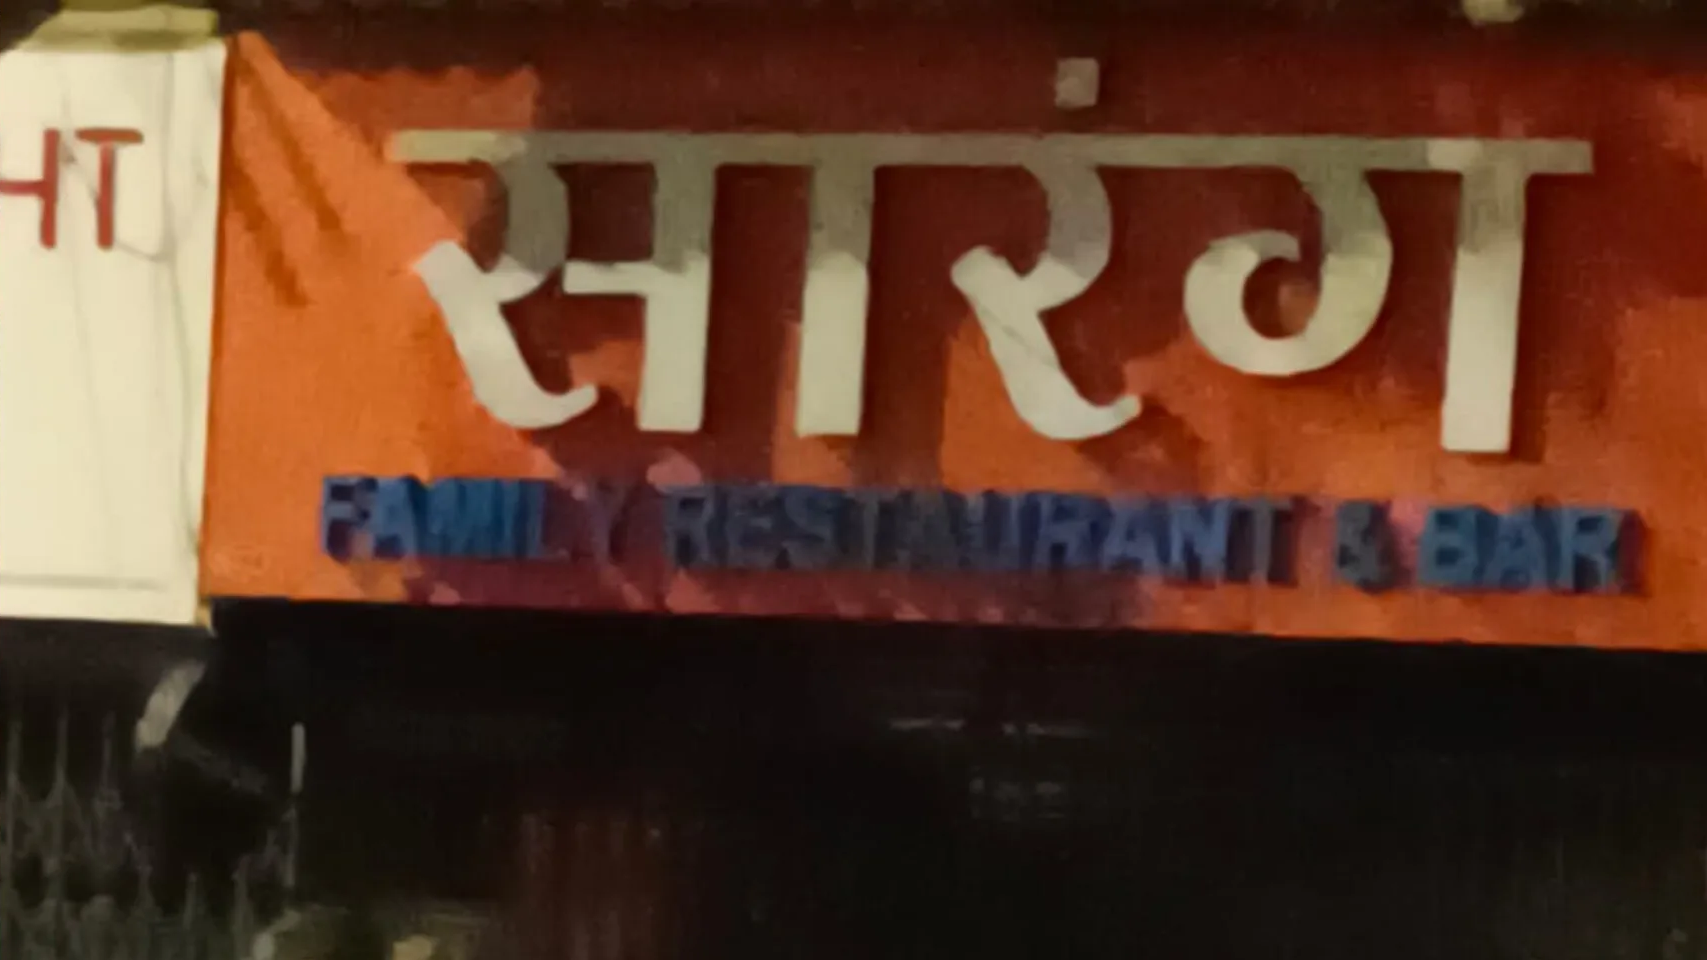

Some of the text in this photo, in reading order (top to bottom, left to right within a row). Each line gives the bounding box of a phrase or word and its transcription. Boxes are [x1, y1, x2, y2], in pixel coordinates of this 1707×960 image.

[386, 58, 1592, 452] सारंग
[321, 475, 1640, 592] FAMILY RESTAURANT & BAR
